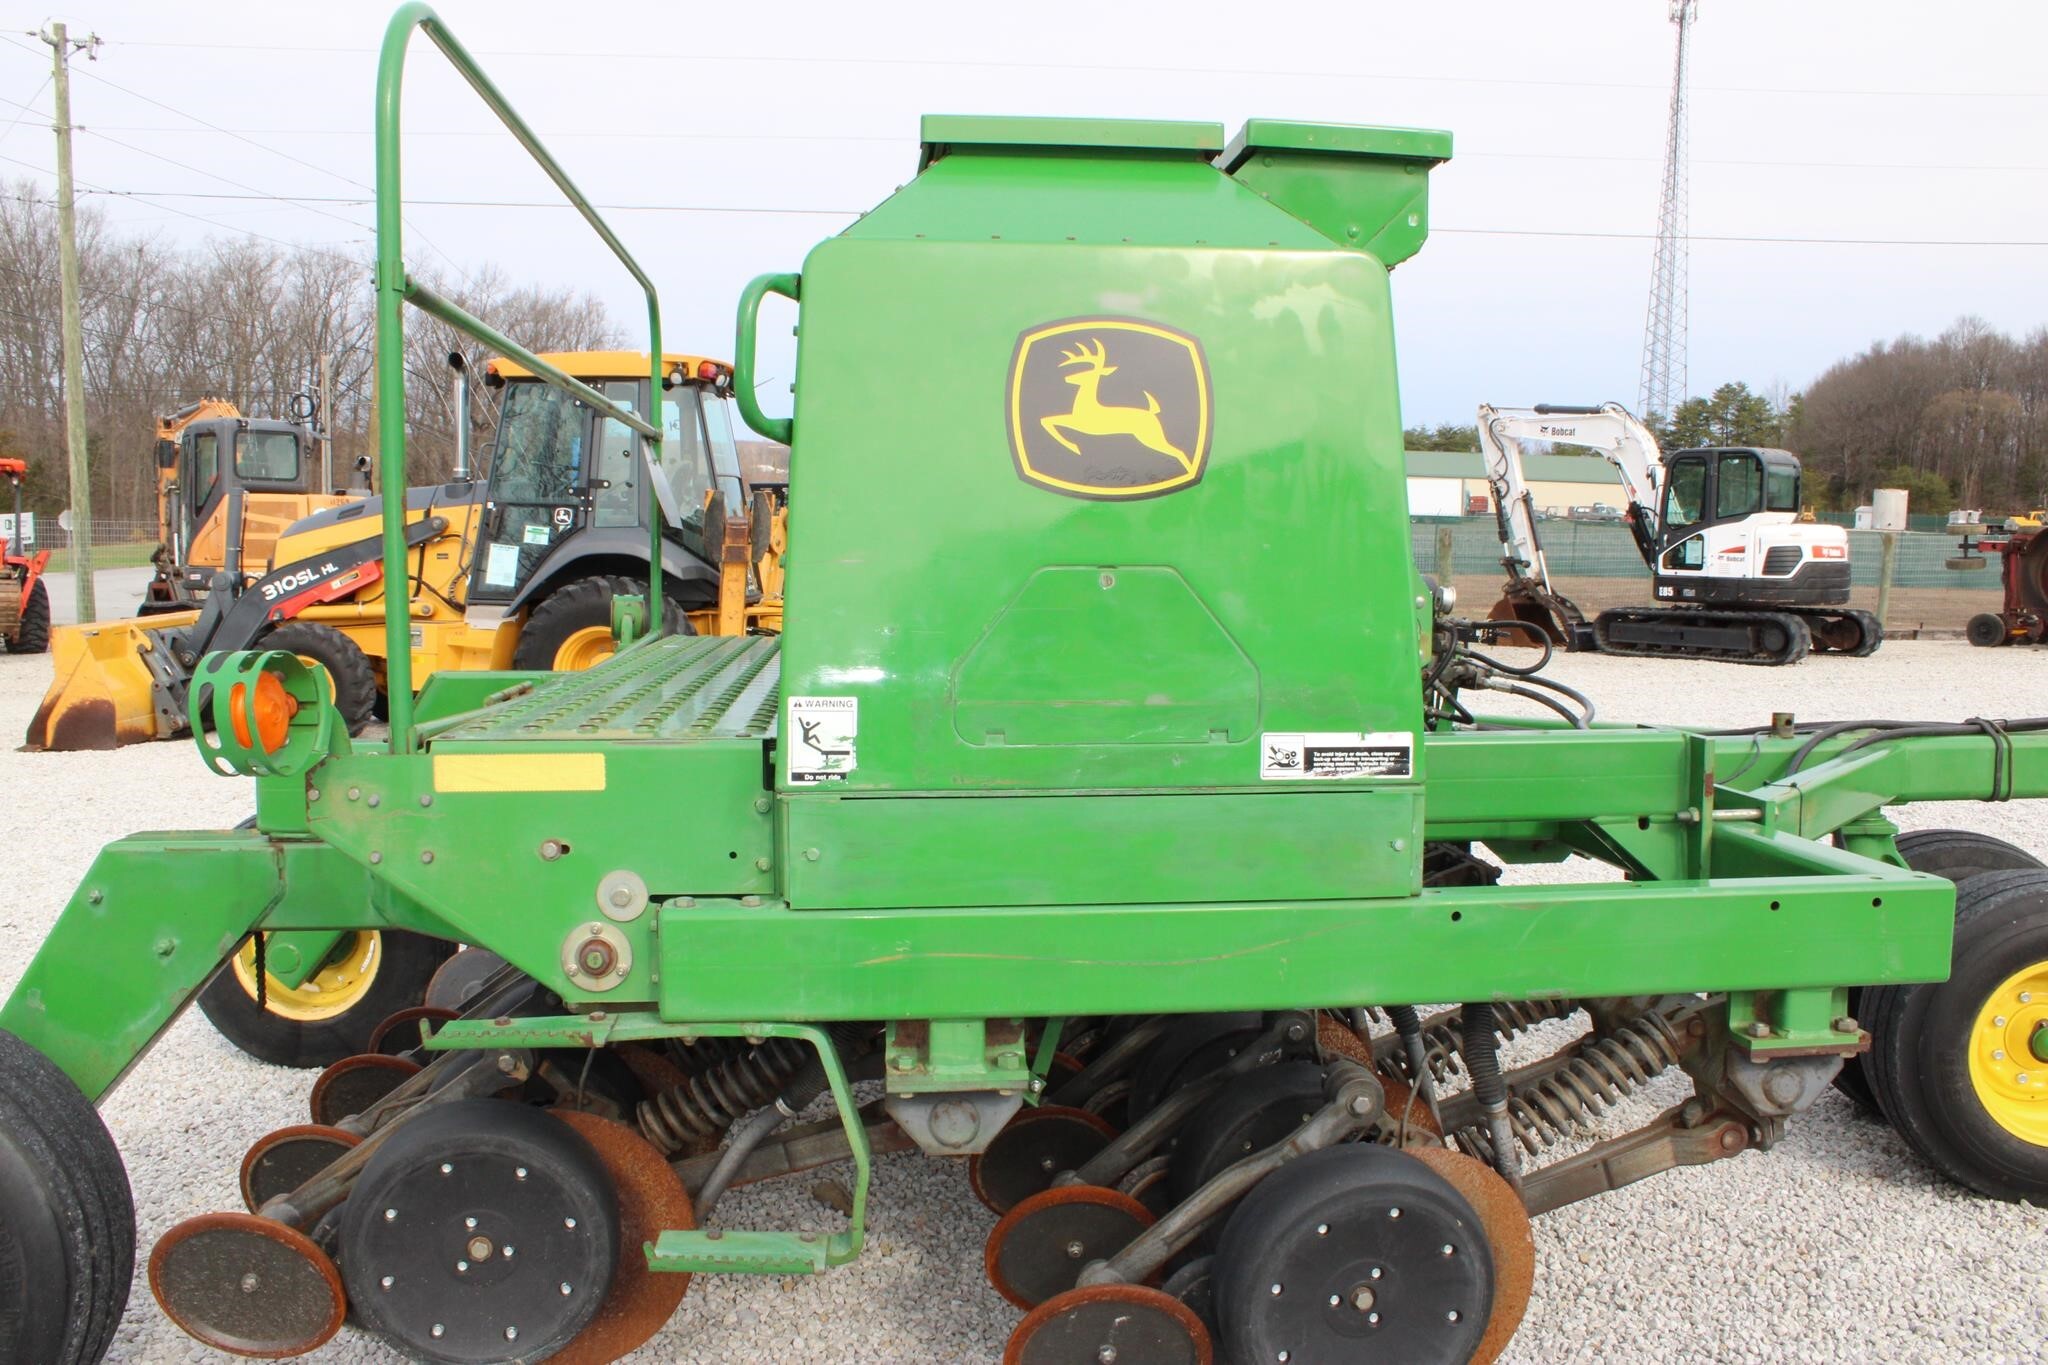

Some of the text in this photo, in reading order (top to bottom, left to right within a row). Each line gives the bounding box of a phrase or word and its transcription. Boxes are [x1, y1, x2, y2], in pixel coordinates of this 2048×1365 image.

[1551, 426, 1576, 436] Bobcat
[261, 568, 320, 601] 310SL
[321, 562, 339, 576] HL
[1658, 586, 1674, 597] E85
[804, 699, 853, 708] WARNING
